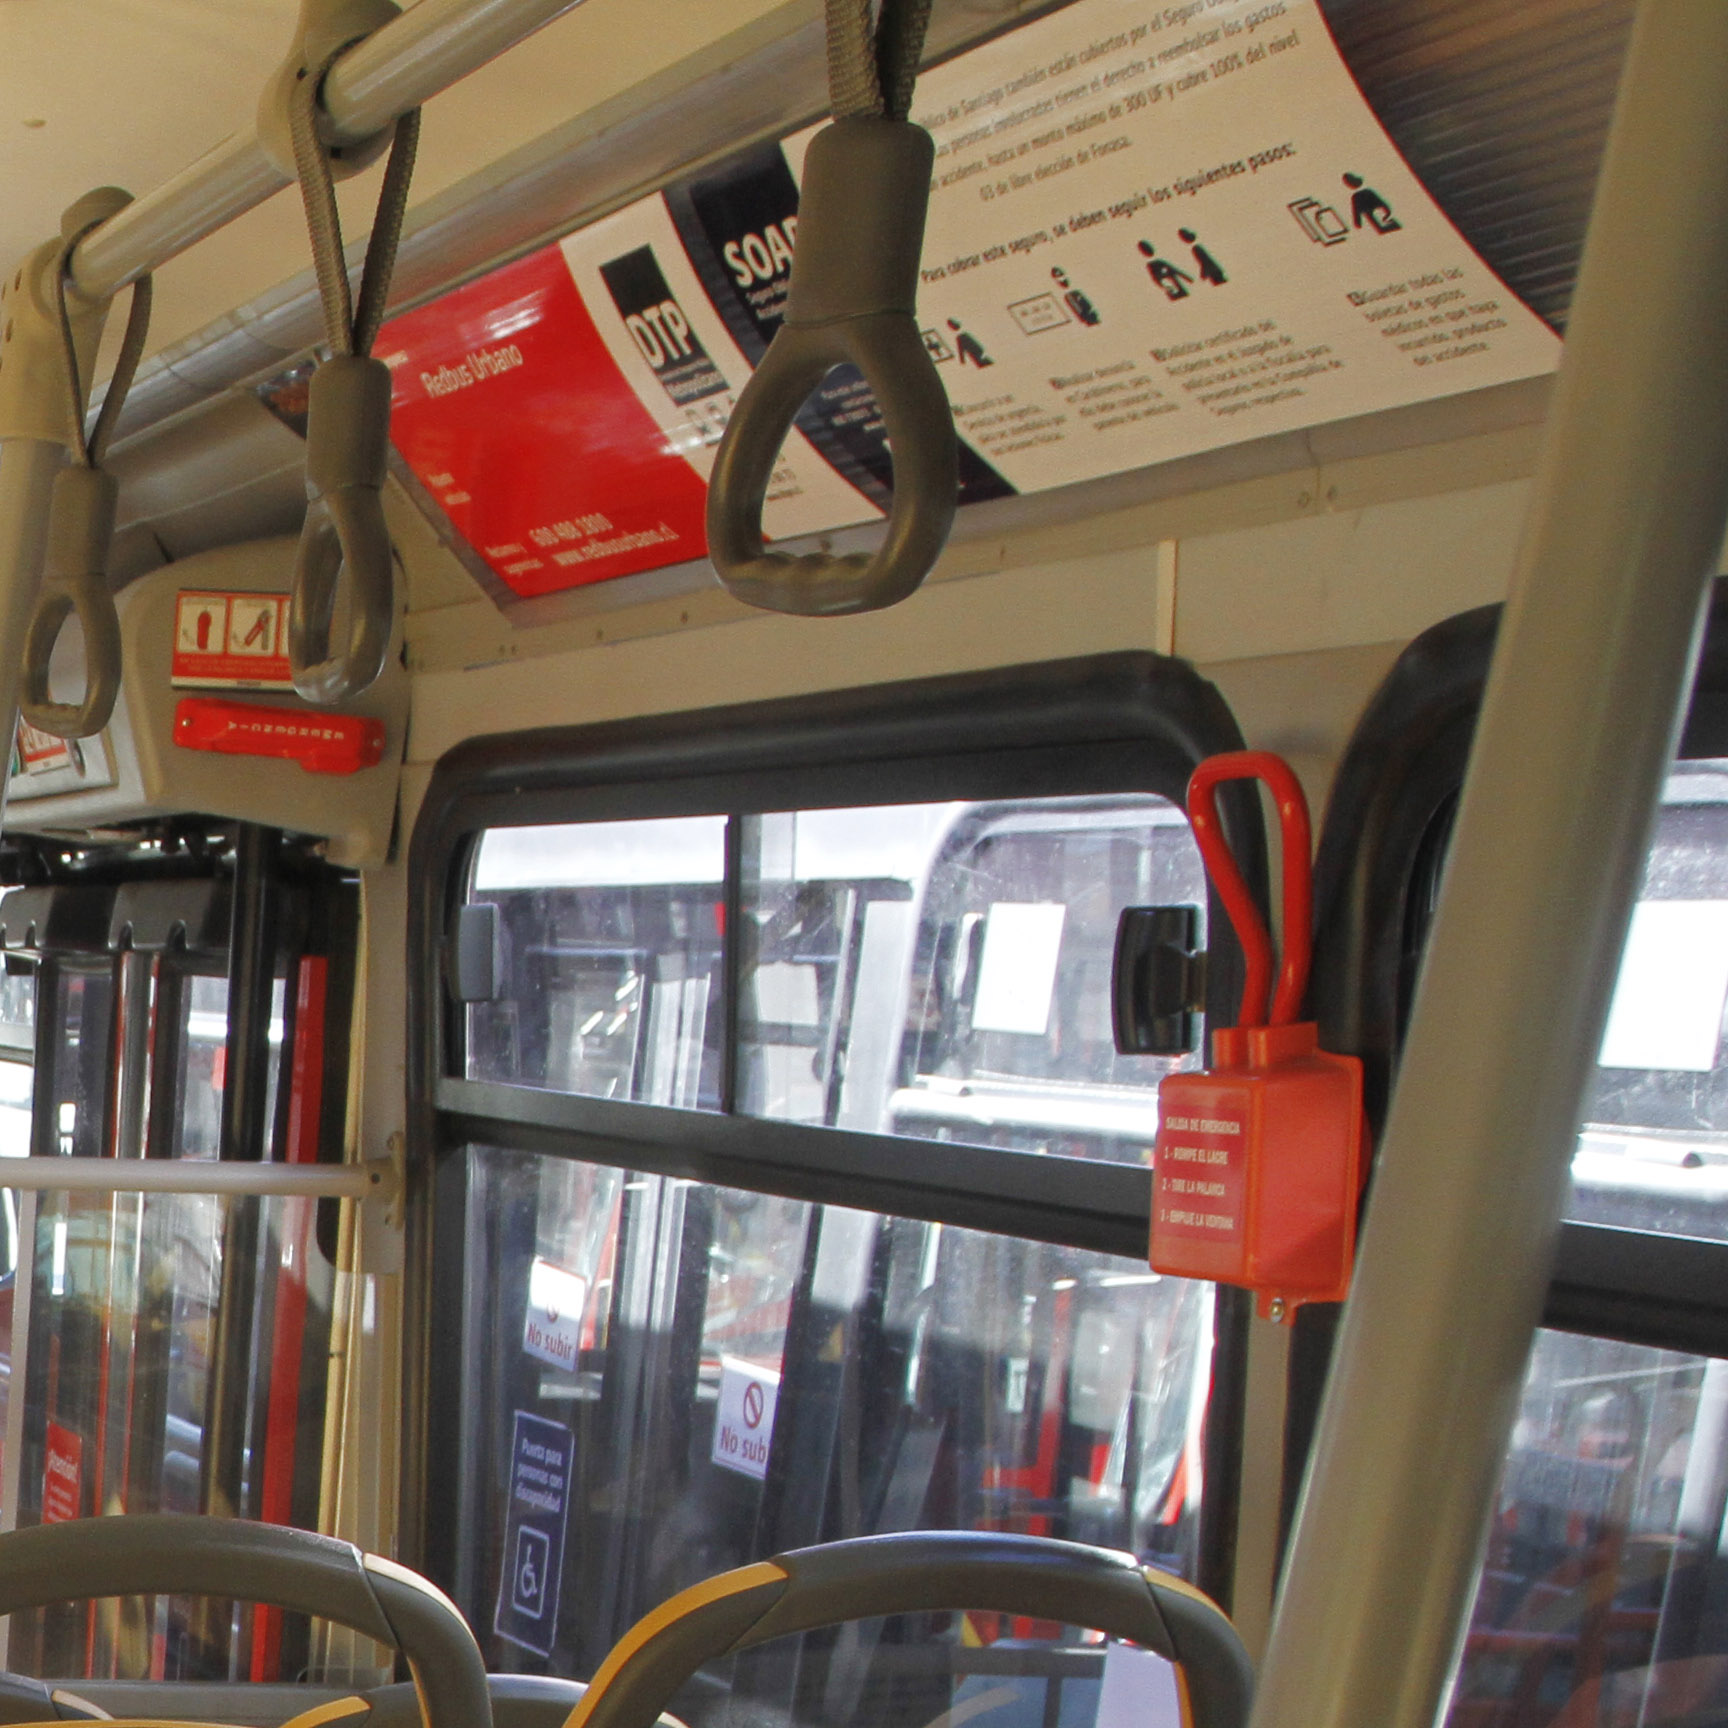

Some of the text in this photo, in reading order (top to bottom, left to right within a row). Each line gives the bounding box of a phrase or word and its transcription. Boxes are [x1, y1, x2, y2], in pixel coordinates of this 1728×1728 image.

[1267, 28, 1301, 56] nivel
[1068, 208, 1107, 234] deben
[1108, 194, 1146, 223] seguir
[1147, 184, 1172, 204] los
[1172, 157, 1247, 197] siguientes
[1247, 141, 1297, 174] pasos:
[625, 299, 691, 370] DTP
[420, 343, 524, 399] Redbus Urbano
[527, 1323, 573, 1361] No subir
[720, 1425, 768, 1465] No sub
